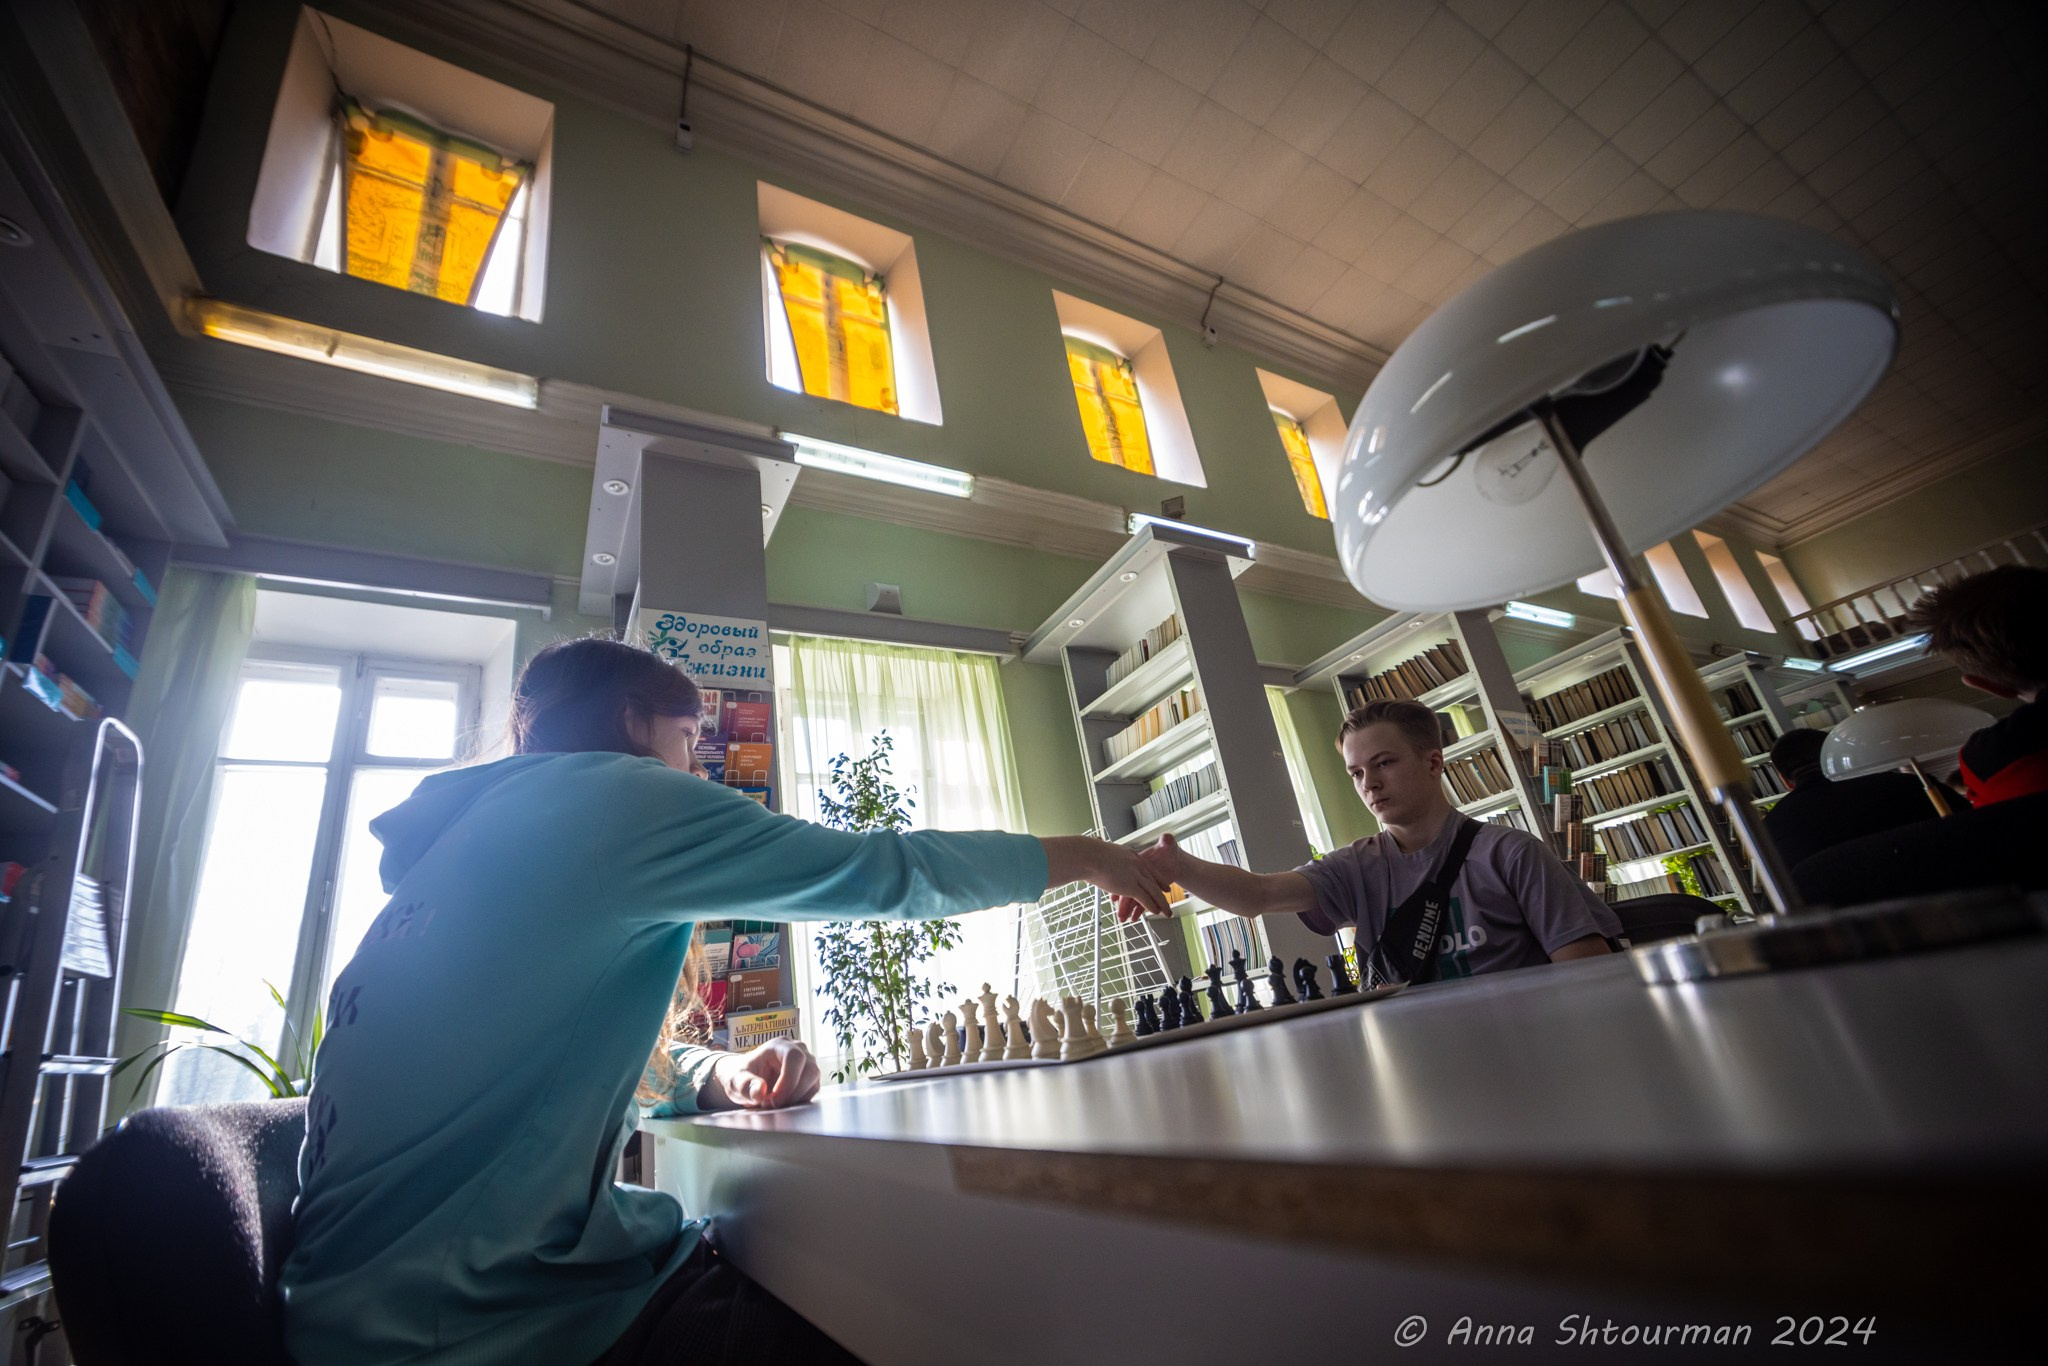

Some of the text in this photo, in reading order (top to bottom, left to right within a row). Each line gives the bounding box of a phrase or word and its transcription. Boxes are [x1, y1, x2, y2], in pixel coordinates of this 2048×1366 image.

[655, 613, 759, 639] Здоровый
[698, 640, 757, 660] образ
[686, 662, 766, 679] жизни
[1412, 899, 1439, 960] GENUINE
[734, 1016, 797, 1034] АЛЬТЕРНАТИВНАЯ
